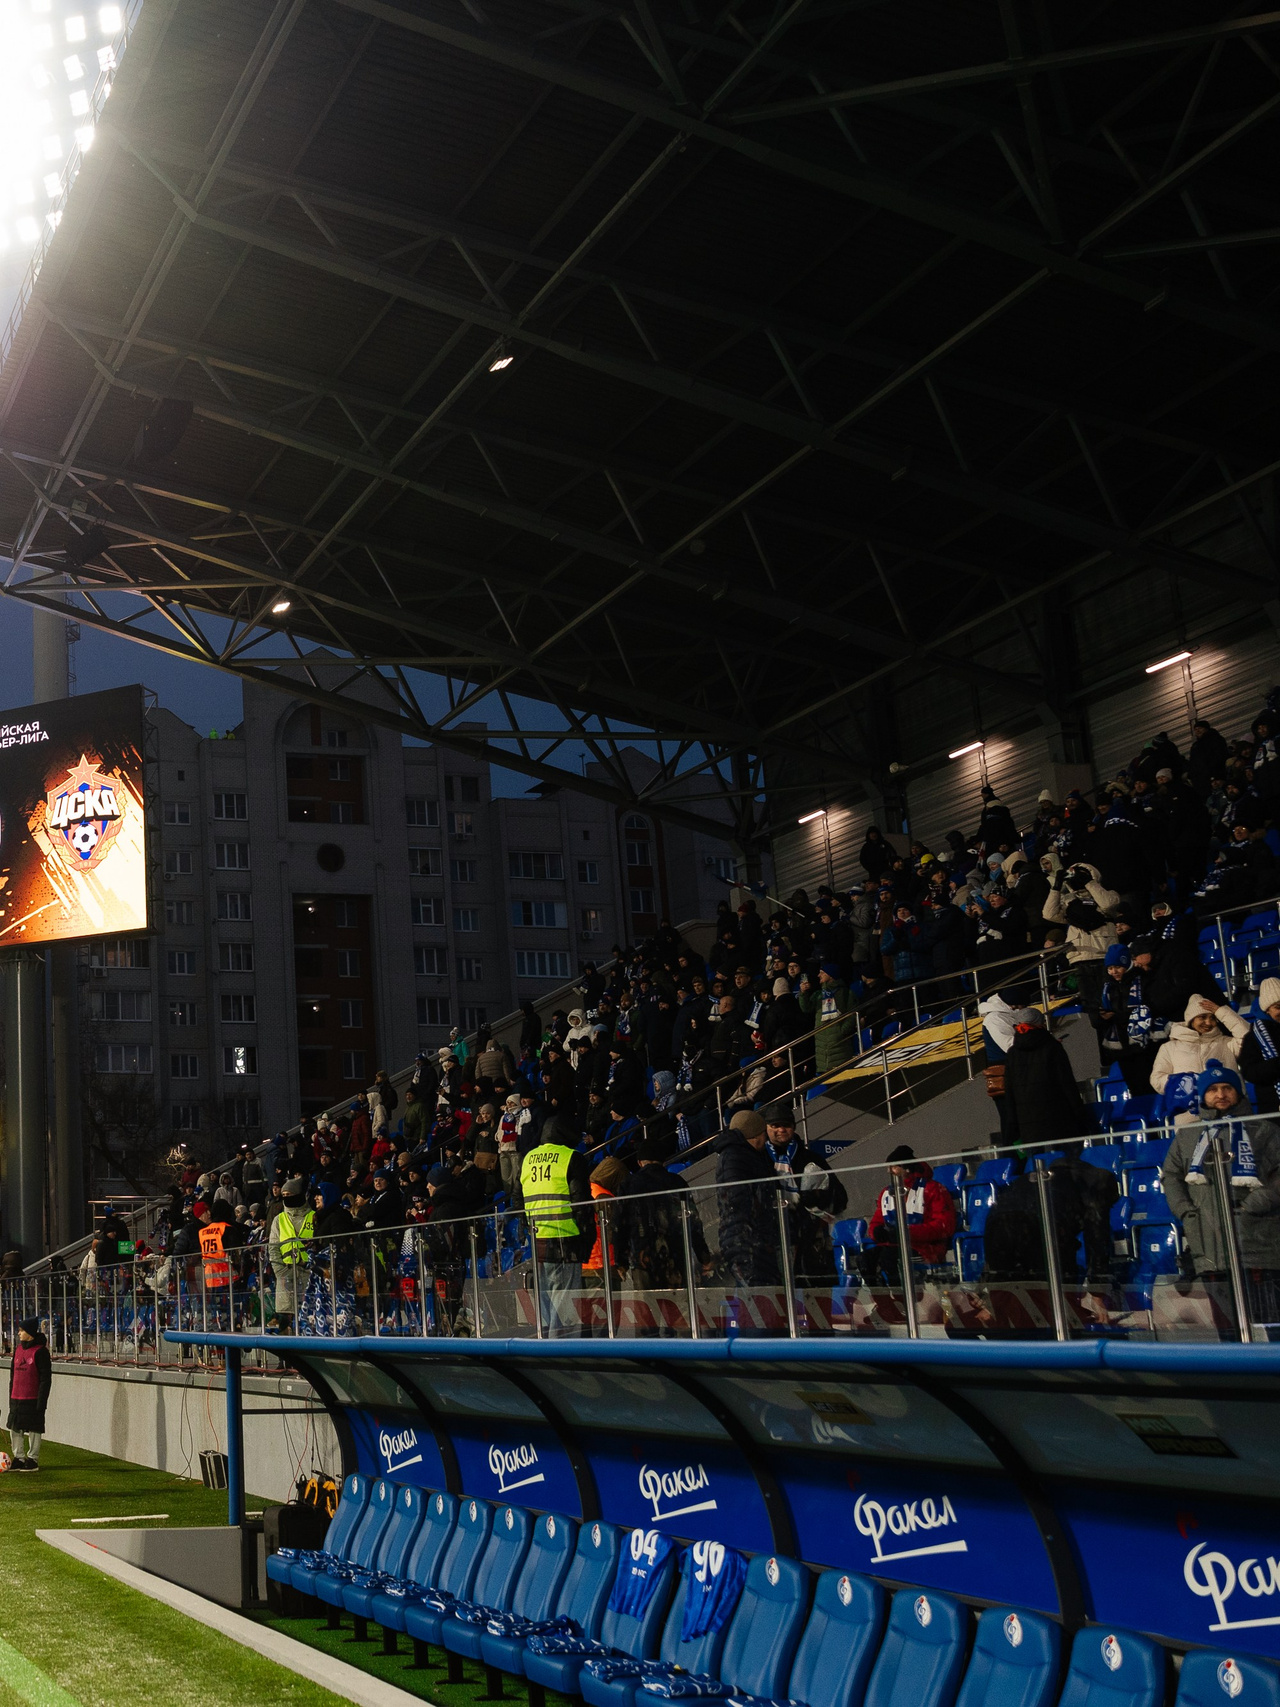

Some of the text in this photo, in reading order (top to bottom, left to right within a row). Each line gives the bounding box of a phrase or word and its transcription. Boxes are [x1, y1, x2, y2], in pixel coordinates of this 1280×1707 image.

[50, 789, 121, 829] ЦСКА
[528, 1152, 560, 1165] СТЮАРД
[824, 1144, 848, 1154] Вхо
[531, 1164, 552, 1183] 314
[202, 1238, 218, 1254] 175
[379, 1427, 422, 1473] Факел
[488, 1442, 544, 1493] Факел
[638, 1462, 717, 1522] Факел
[853, 1493, 968, 1563] Факел
